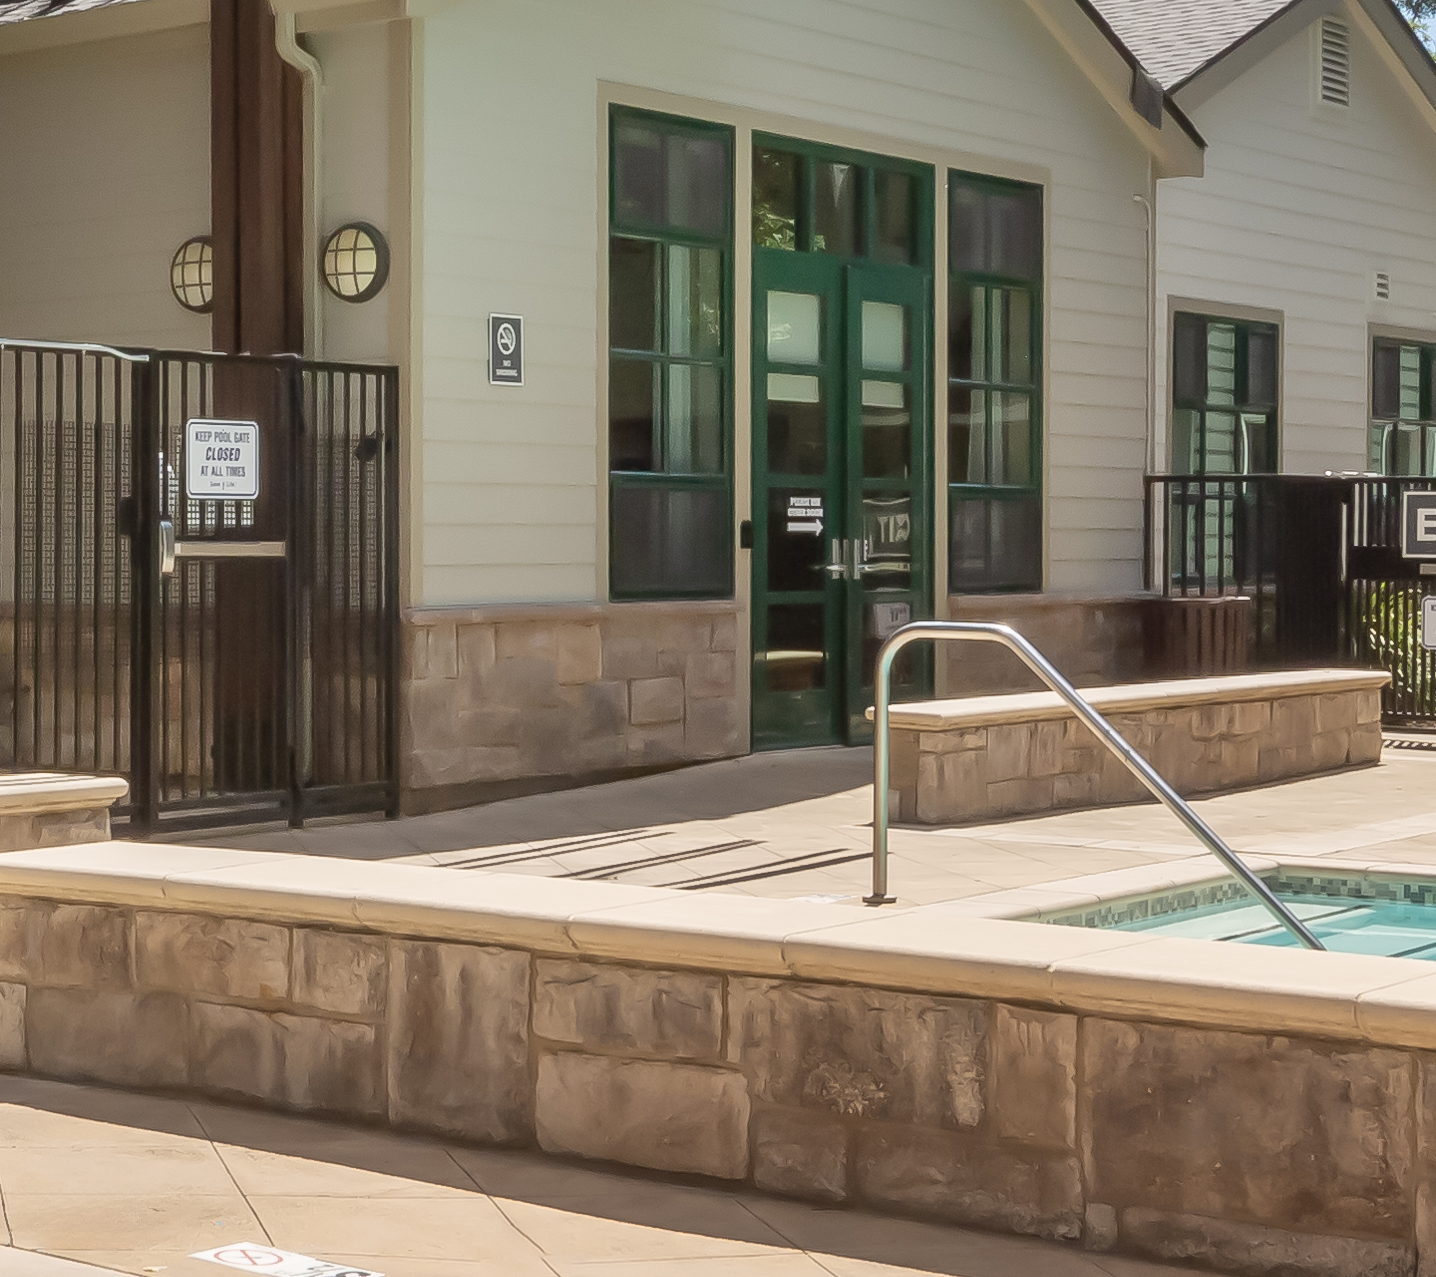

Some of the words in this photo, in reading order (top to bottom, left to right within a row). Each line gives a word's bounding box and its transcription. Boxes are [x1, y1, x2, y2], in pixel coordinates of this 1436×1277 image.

[195, 431, 212, 442] KEEP
[214, 431, 232, 443] POOL
[234, 432, 250, 444] GATE
[206, 447, 241, 462] CLOSED
[201, 465, 208, 476] AT
[211, 465, 224, 477] ALL
[226, 466, 246, 477] TIMES
